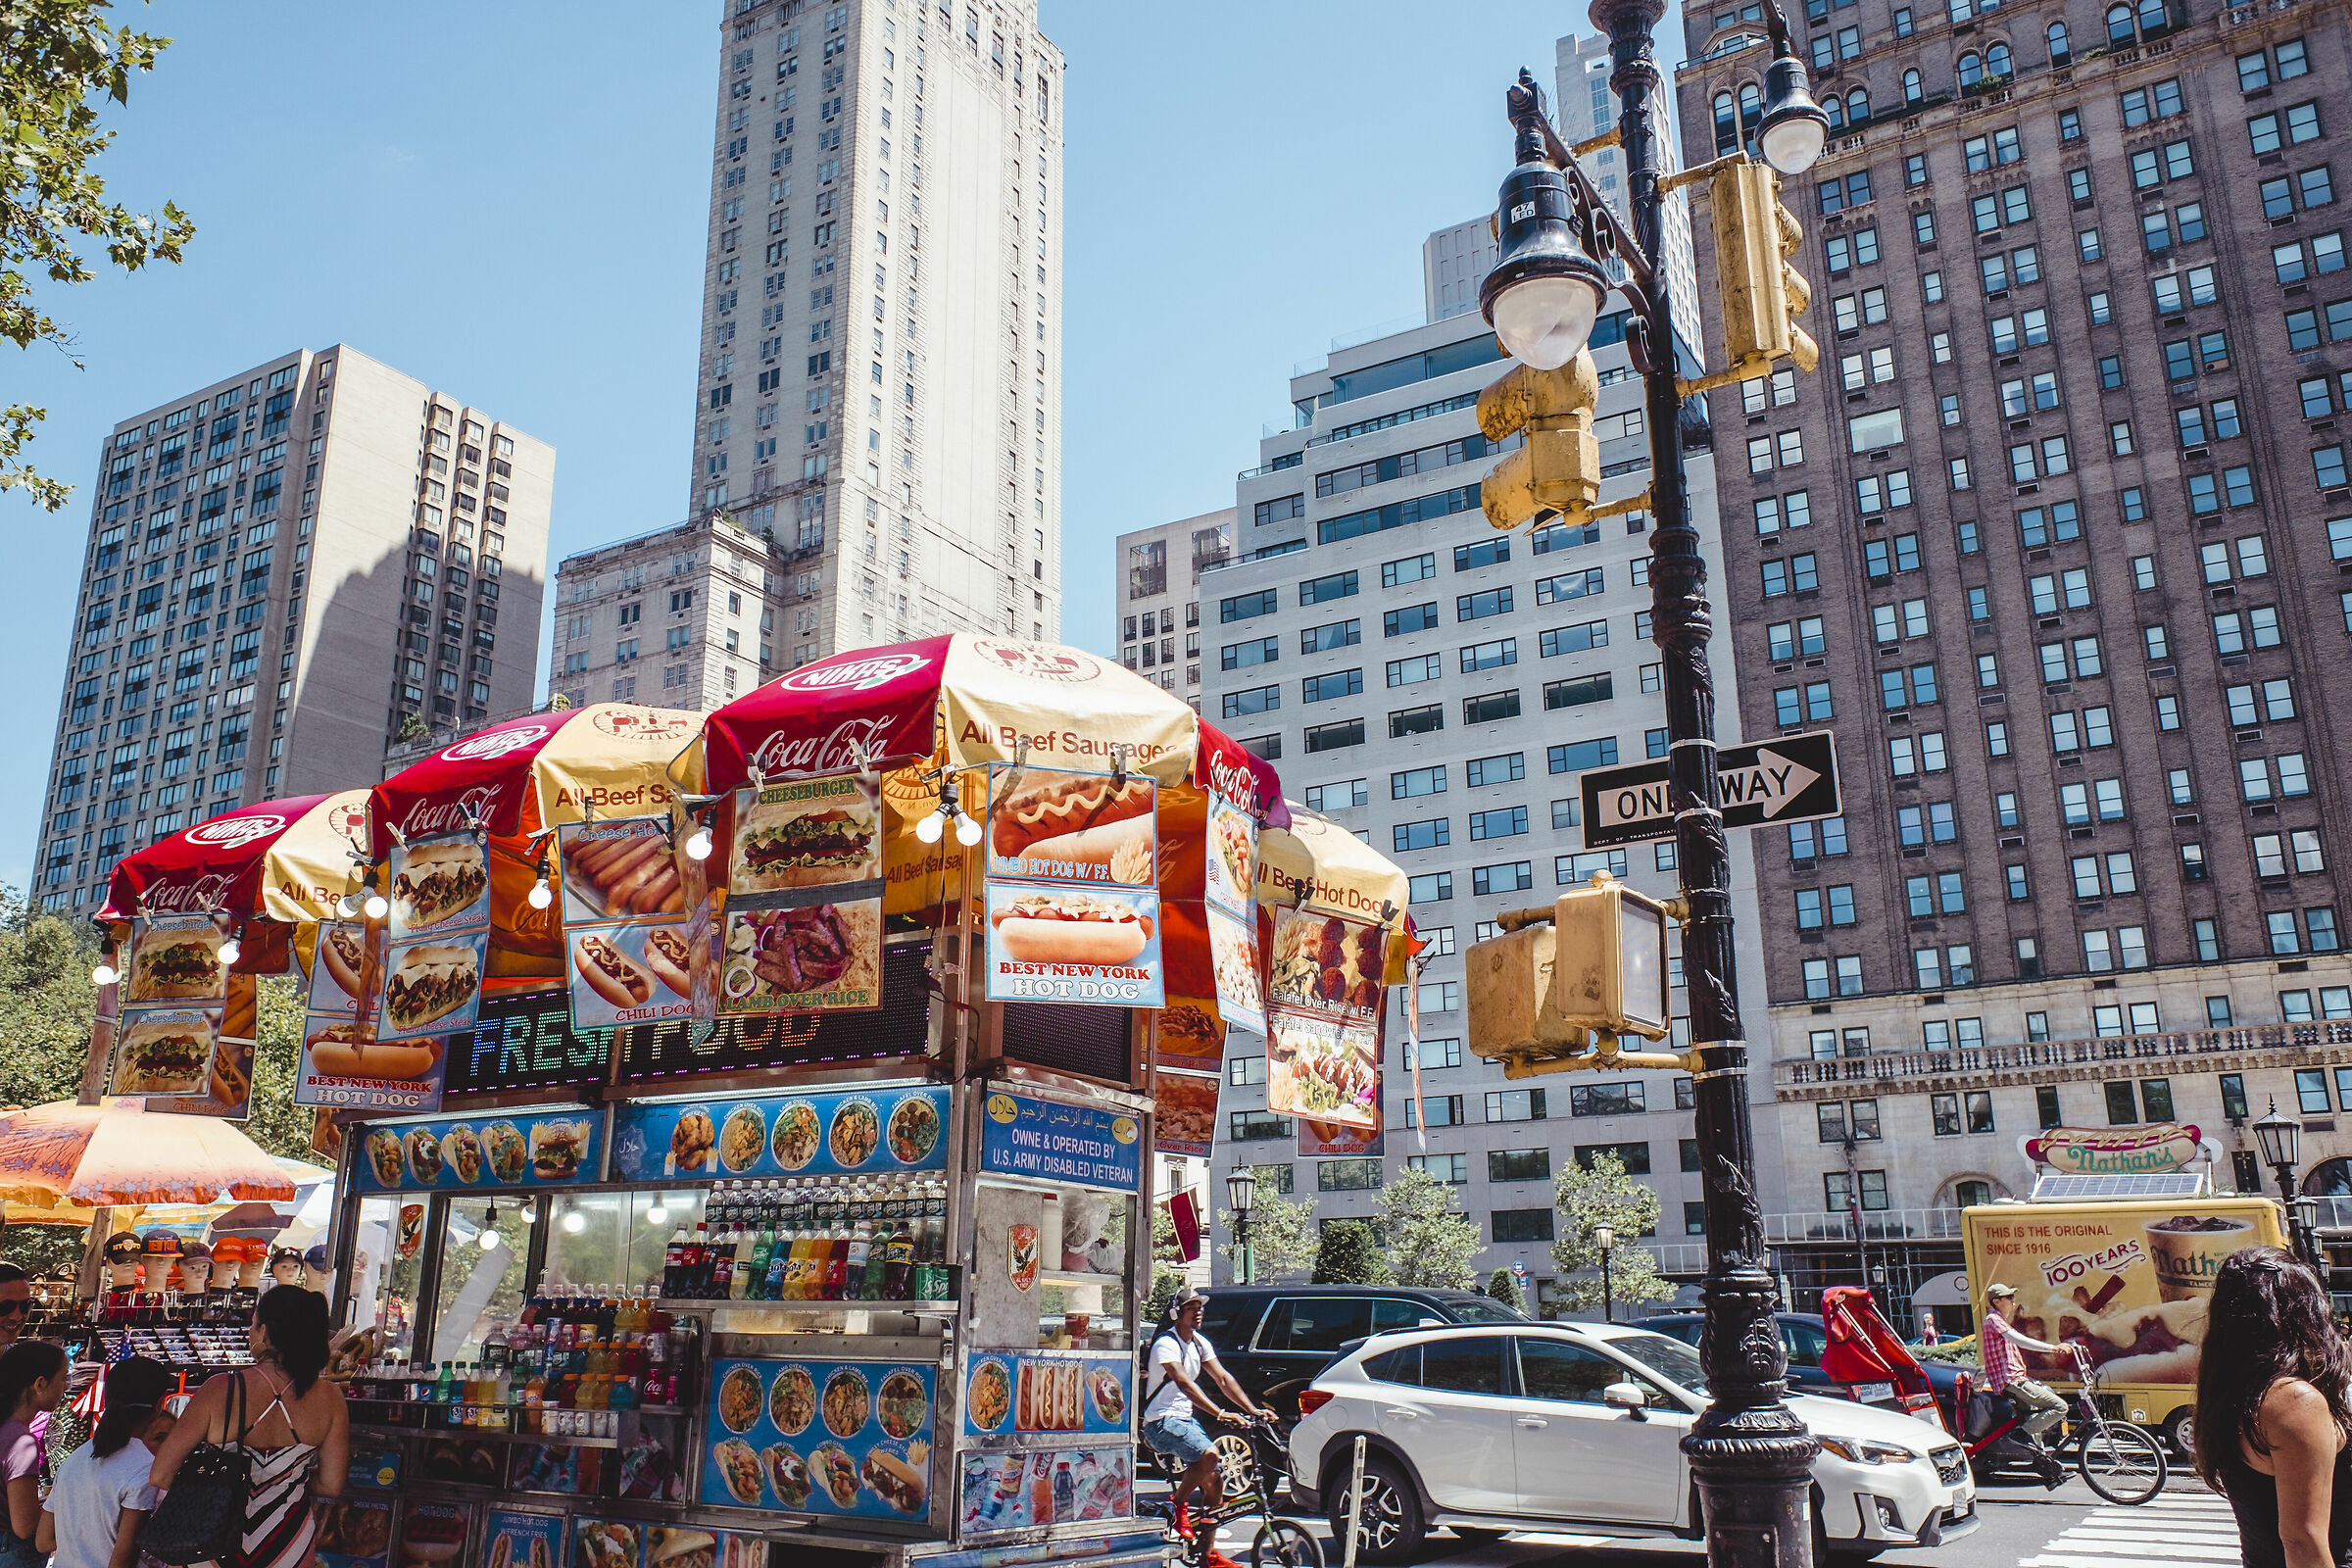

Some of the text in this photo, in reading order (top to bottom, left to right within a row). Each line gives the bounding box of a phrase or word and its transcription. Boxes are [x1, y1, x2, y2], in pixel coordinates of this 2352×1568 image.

[1513, 209, 1534, 220] LED
[1516, 203, 1529, 212] 47
[801, 659, 902, 686] NIKAS
[960, 720, 993, 745] All
[755, 714, 899, 772] Coca-Cola
[760, 777, 856, 806] CHEESEBURGER
[1719, 764, 1792, 805] WAY
[556, 787, 585, 808] All
[591, 784, 645, 808] Beef
[1630, 828, 1677, 840] TRANSPORTATI
[991, 856, 1028, 874] JUMBO
[1029, 858, 1051, 876] HOT
[1052, 860, 1075, 878] DOG
[279, 881, 307, 902] All
[1257, 861, 1269, 883] ll
[1316, 879, 1345, 906] Hot
[464, 913, 486, 925] Steak
[999, 962, 1152, 980] BEST NEW YORK
[1012, 978, 1140, 1000] HOT DOG
[1272, 987, 1302, 1005] Falafel
[1304, 995, 1327, 1009] Over
[727, 994, 774, 1010] LAMB
[777, 991, 823, 1007] OVER
[827, 989, 868, 1004] RICE
[449, 1016, 472, 1028] Steak
[615, 1006, 658, 1022] CHILI
[307, 1075, 432, 1093] BEST NEW YORK
[316, 1088, 420, 1108] HOT DOG
[1011, 1128, 1116, 1159] OWNE & OPERATED BY
[1159, 1140, 1204, 1154] Over Rice
[1318, 1143, 1365, 1153] CHILI DOG
[993, 1149, 1133, 1184] U.S. ARMY DISABLED VETERAN
[2067, 1145, 2180, 1174] Nathan's
[1984, 1224, 2113, 1239] THIS IS THE ORIGINAL
[1986, 1243, 2051, 1254] SINCE 1916
[2046, 1240, 2139, 1286] 100 YEARS
[1021, 1358, 1037, 1367] NEW
[1037, 1359, 1055, 1368] YORK
[1055, 1359, 1069, 1368] HOT
[417, 1503, 456, 1519] HOT DOG
[501, 1516, 522, 1526] JUMBO
[534, 1518, 549, 1527] DOG
[530, 1530, 548, 1539] FRIES
